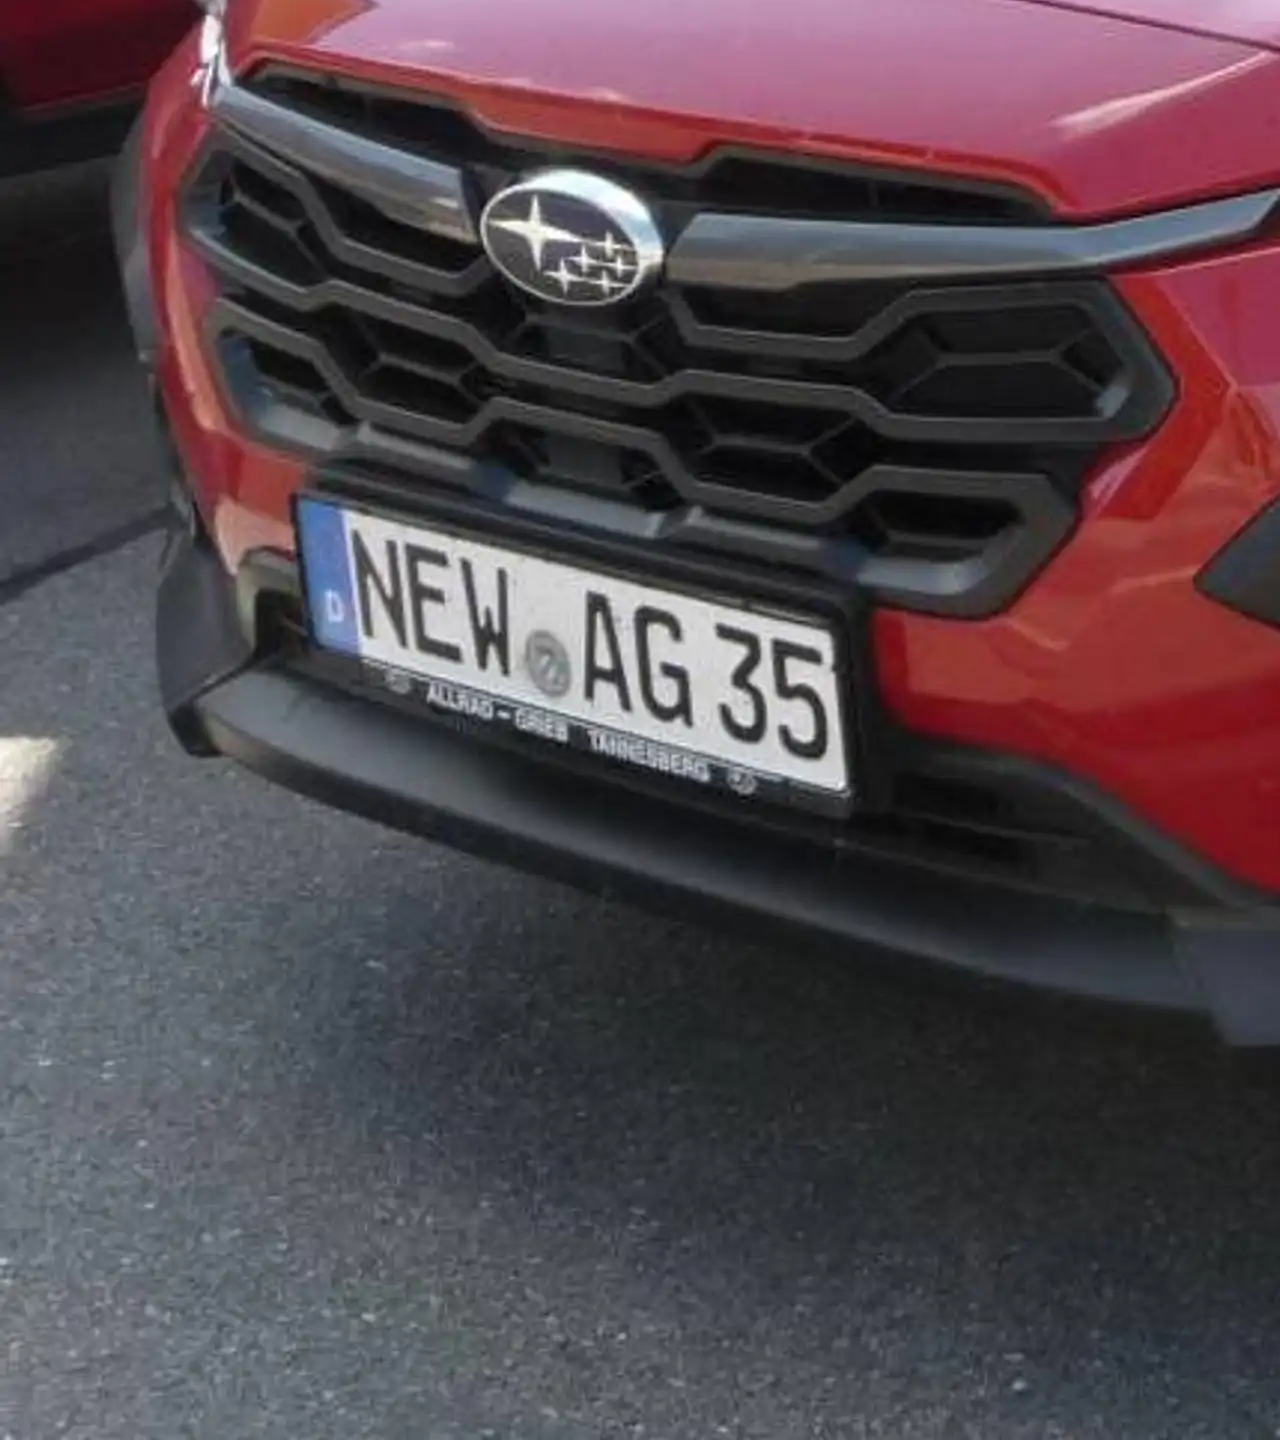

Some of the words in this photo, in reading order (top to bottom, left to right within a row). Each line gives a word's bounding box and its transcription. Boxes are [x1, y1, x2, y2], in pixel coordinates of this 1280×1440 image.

[325, 589, 345, 622] D
[351, 530, 511, 677] NEW
[584, 591, 693, 727] AG
[715, 622, 828, 761] 35
